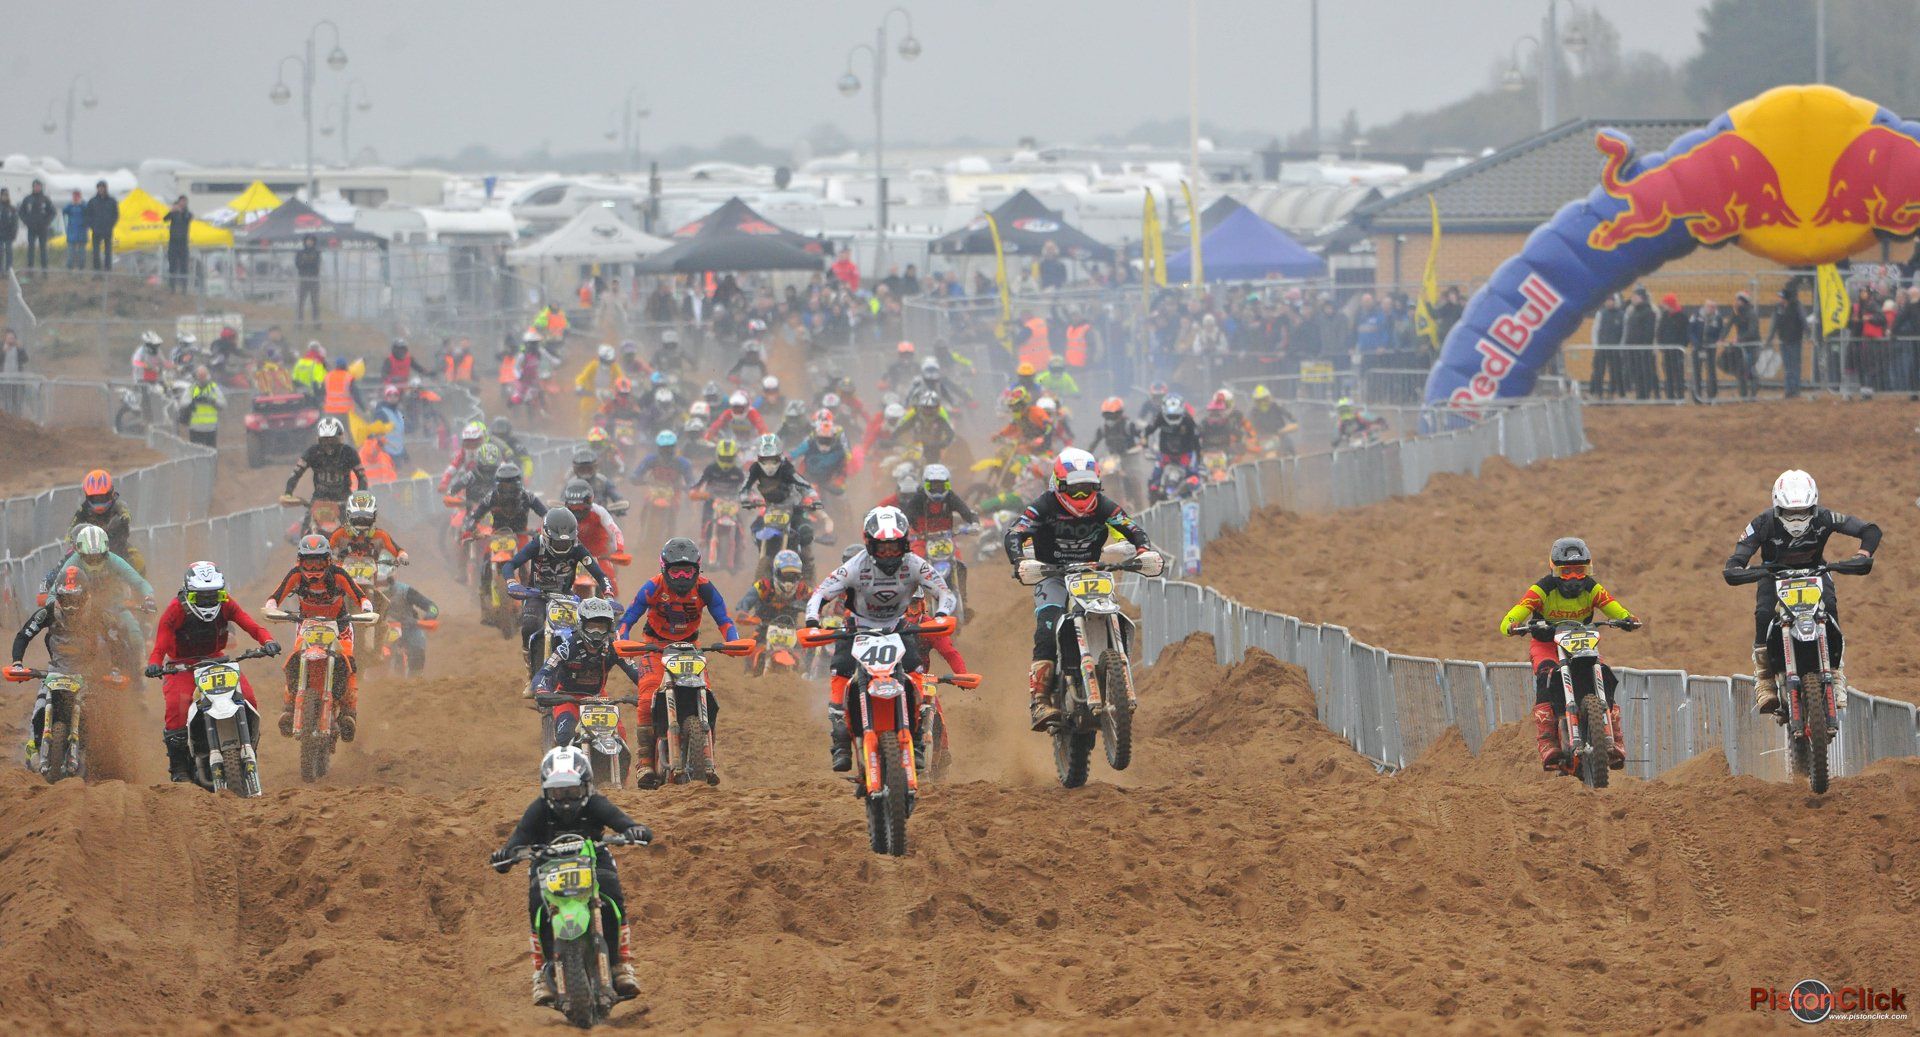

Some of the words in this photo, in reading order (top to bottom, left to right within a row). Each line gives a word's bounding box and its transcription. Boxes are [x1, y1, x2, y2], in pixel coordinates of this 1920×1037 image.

[1448, 340, 1515, 420] Red
[1488, 273, 1563, 354] Bull
[1083, 581, 1099, 593] 12
[1797, 589, 1803, 603] 1
[1570, 640, 1589, 652] 26
[860, 645, 897, 666] 40
[680, 662, 694, 673] 18
[212, 674, 226, 688] 13
[592, 714, 608, 726] 53
[559, 872, 581, 889] 30
